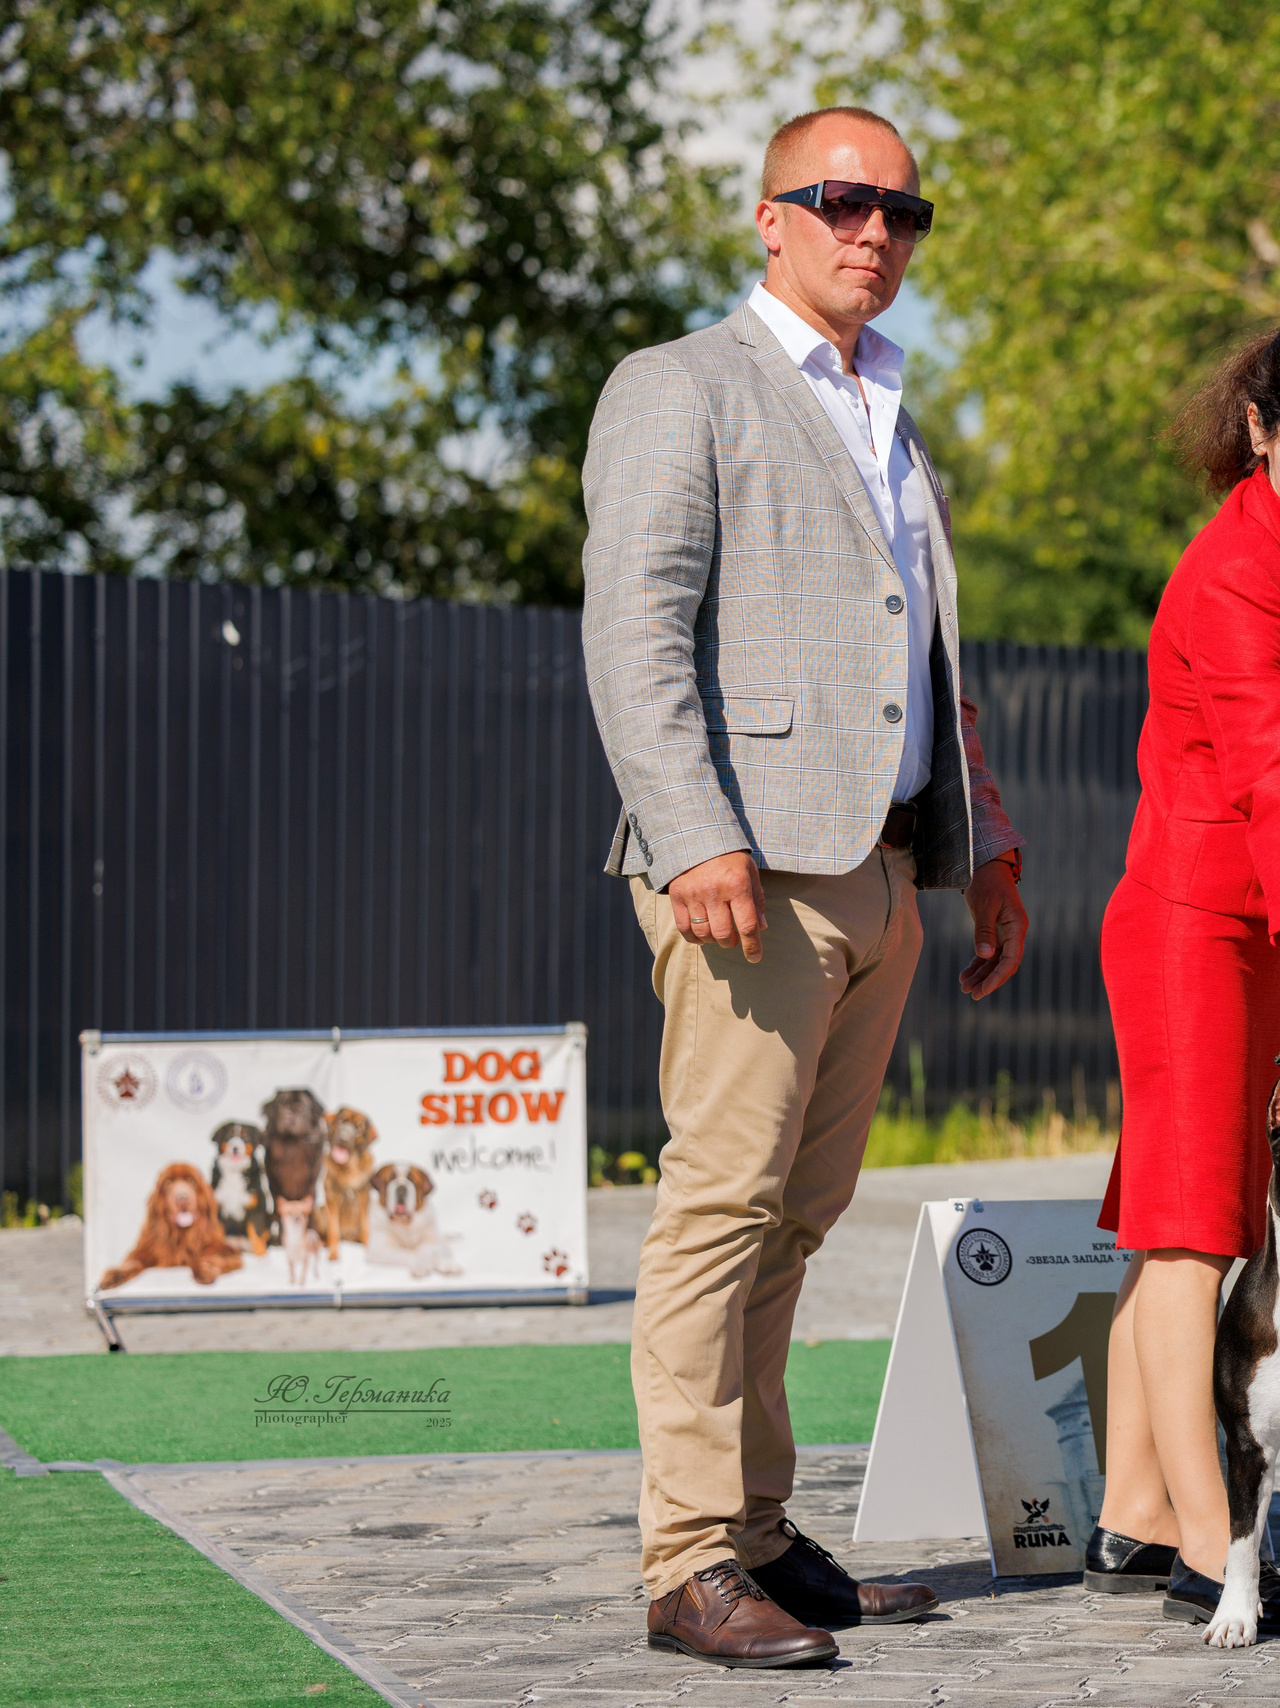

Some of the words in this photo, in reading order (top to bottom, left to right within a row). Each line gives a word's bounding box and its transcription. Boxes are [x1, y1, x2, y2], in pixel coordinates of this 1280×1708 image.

[443, 1051, 540, 1083] DOG
[420, 1091, 566, 1125] SHOW
[432, 1132, 556, 1173] welcome!
[1072, 1254, 1114, 1264] ЗАПАДА
[1029, 1292, 1117, 1476] 1
[1013, 1532, 1071, 1548] RUNA
